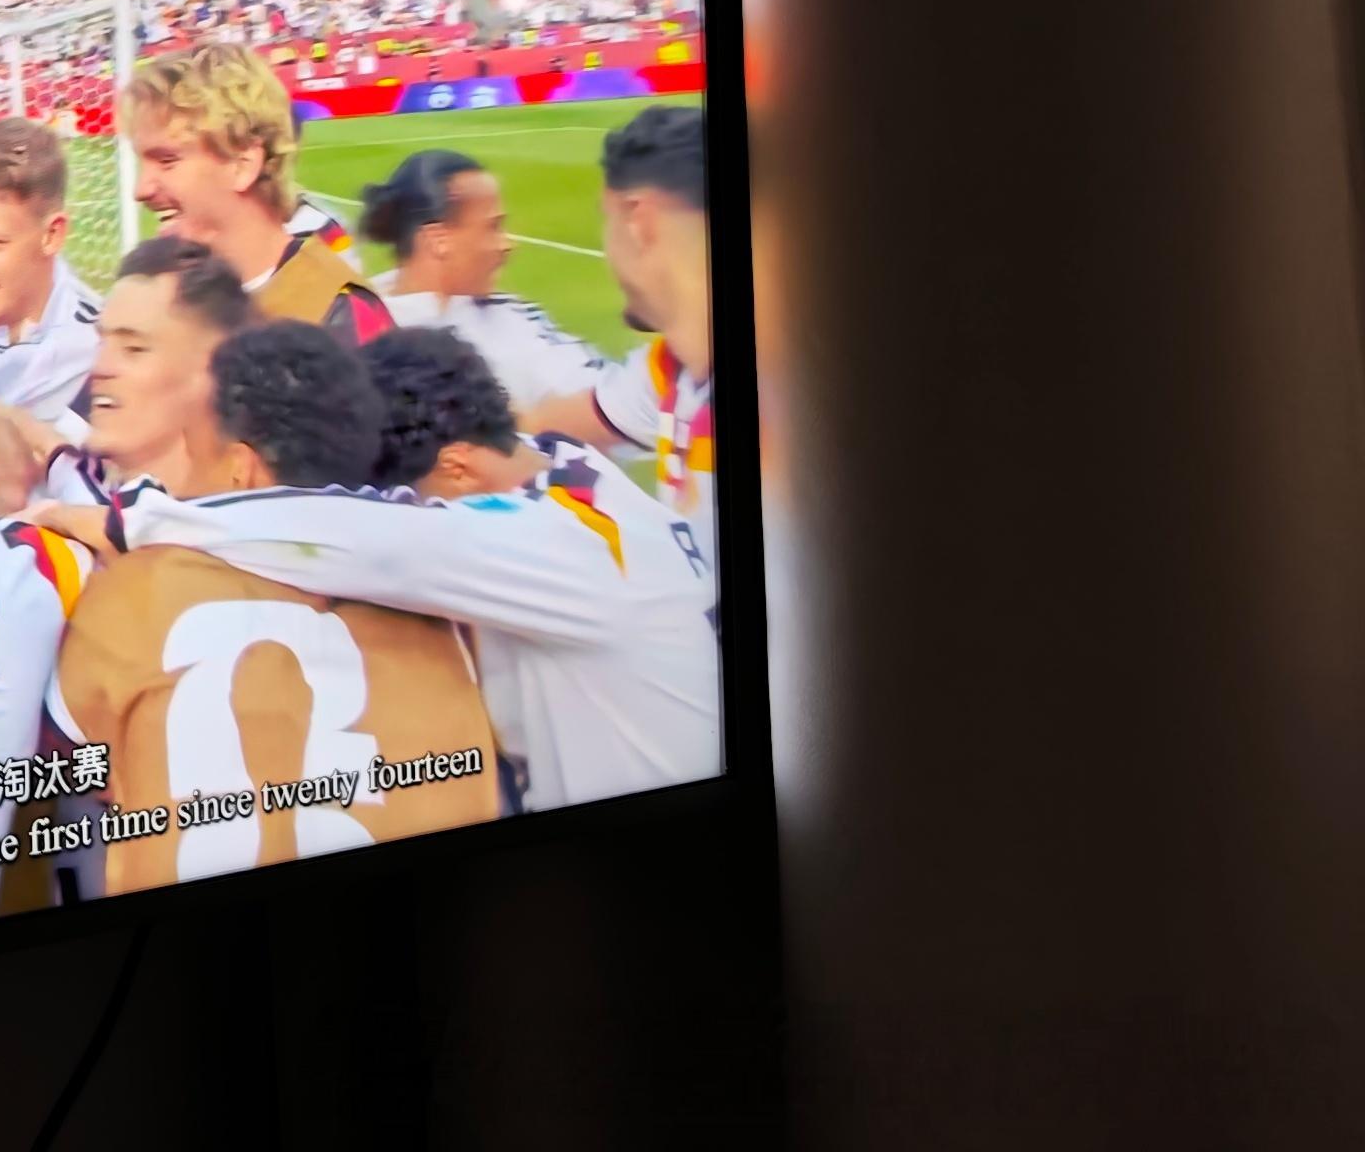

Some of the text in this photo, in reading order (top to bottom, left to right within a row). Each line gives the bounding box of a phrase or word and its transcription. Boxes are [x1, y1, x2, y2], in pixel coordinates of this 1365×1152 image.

[29, 815, 92, 856] first
[100, 804, 169, 843] time
[176, 786, 254, 828] since
[262, 767, 359, 812] twenty
[367, 747, 482, 792] fourteen
